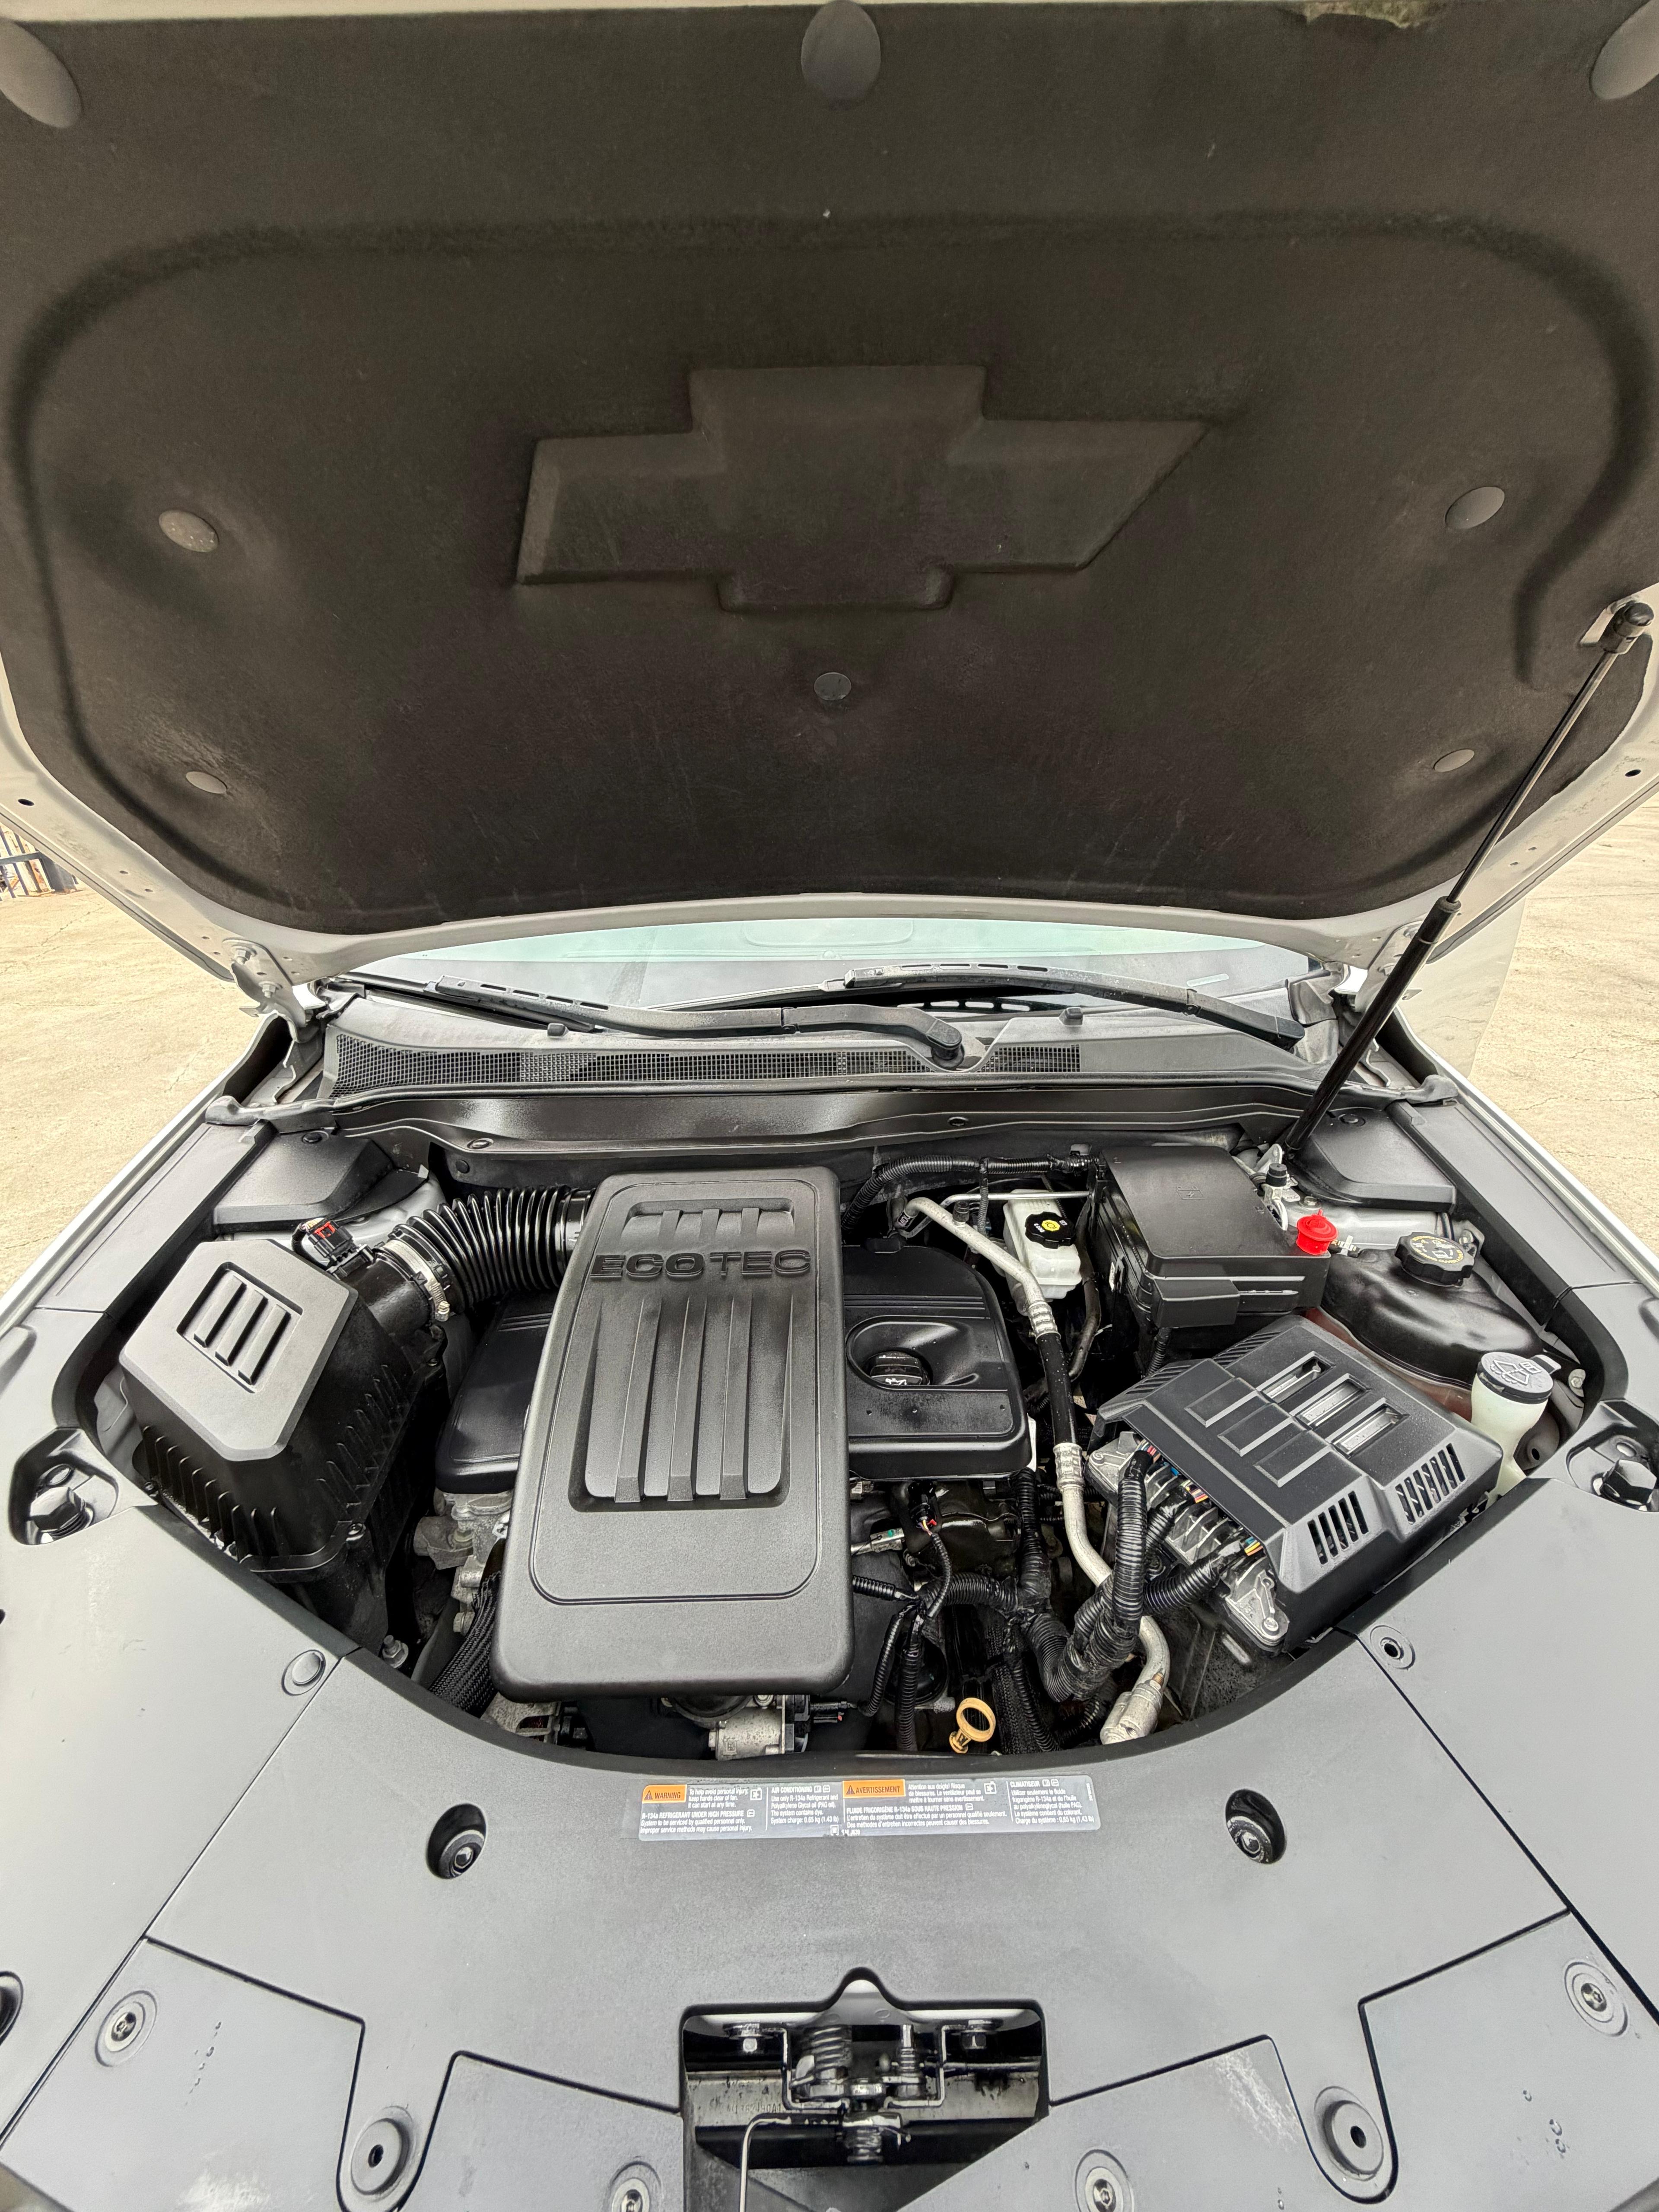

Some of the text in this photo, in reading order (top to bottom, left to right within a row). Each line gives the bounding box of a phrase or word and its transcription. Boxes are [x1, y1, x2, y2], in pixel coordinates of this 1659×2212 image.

[590, 1249, 810, 1279] ECOTEC
[856, 1786, 900, 1794] AVERTISSEMENT
[864, 1805, 894, 1814] FRIGORIGÈNE
[1020, 1810, 1039, 1818] système
[770, 1817, 787, 1825] System
[821, 1815, 833, 1824] (1.43
[1015, 1817, 1031, 1825] Charge
[1038, 1816, 1056, 1824] système
